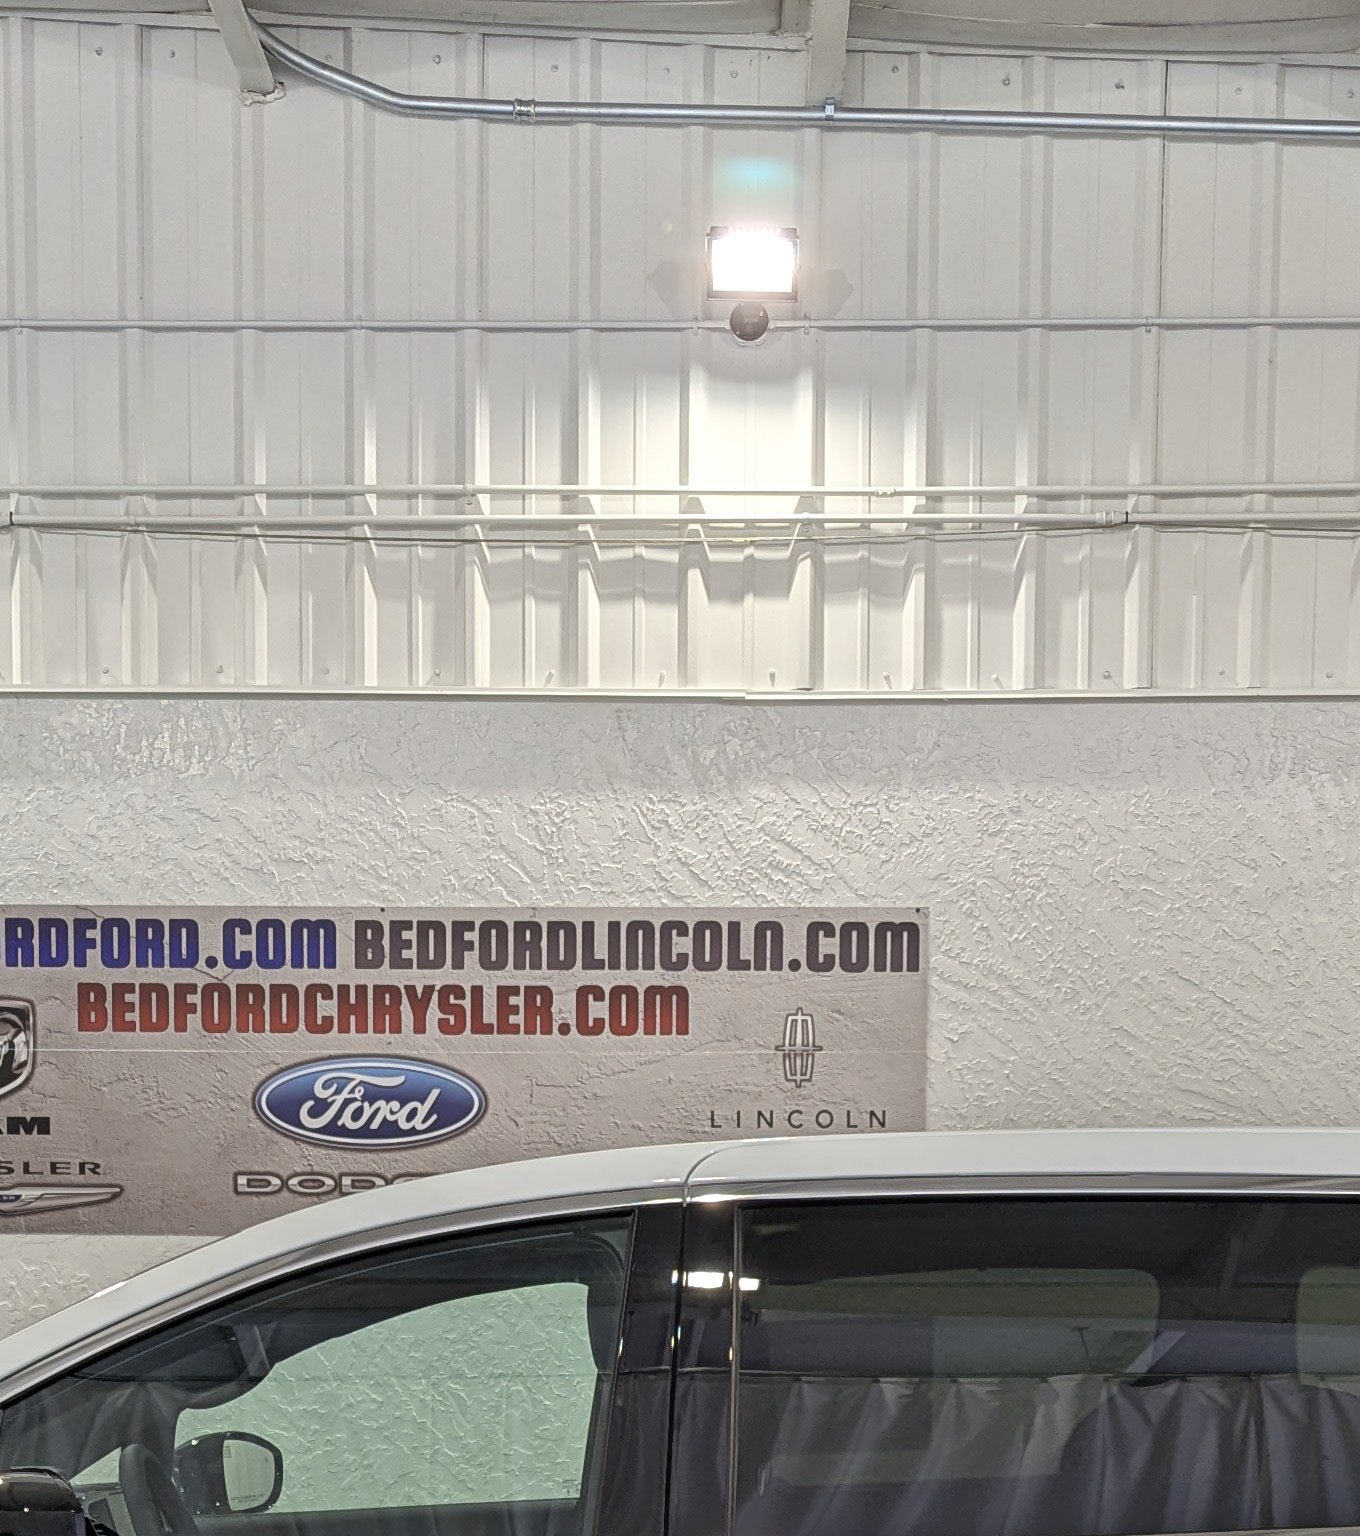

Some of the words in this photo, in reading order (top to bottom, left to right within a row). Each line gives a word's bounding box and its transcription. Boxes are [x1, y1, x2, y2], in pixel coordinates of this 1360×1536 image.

[354, 919, 921, 973] BEDFORDLINCOLN.COM
[77, 983, 690, 1035] BEDFORDCHRYSLER.COM
[299, 1072, 441, 1131] Ford
[710, 1109, 888, 1129] LINCOLN
